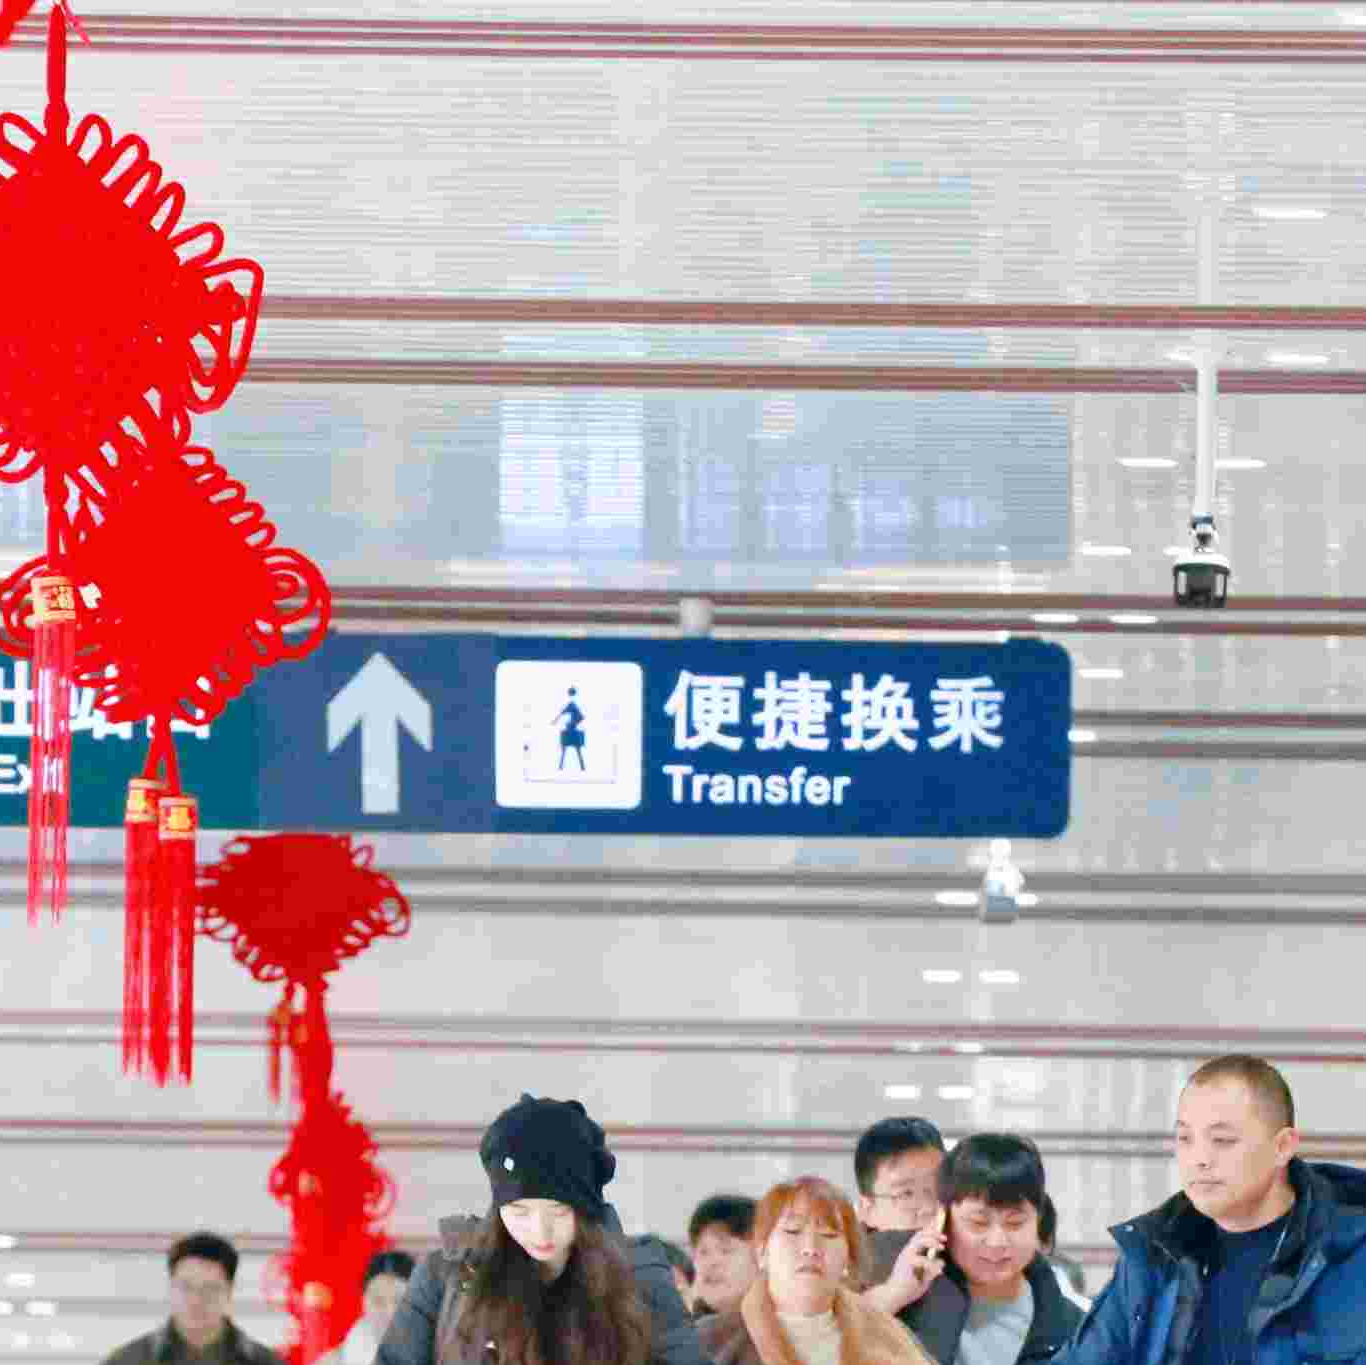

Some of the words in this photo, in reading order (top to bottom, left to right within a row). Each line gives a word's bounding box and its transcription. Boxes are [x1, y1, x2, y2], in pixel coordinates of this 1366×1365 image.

[663, 669, 1006, 754] 便捷换乘
[662, 764, 852, 806] Transfer
